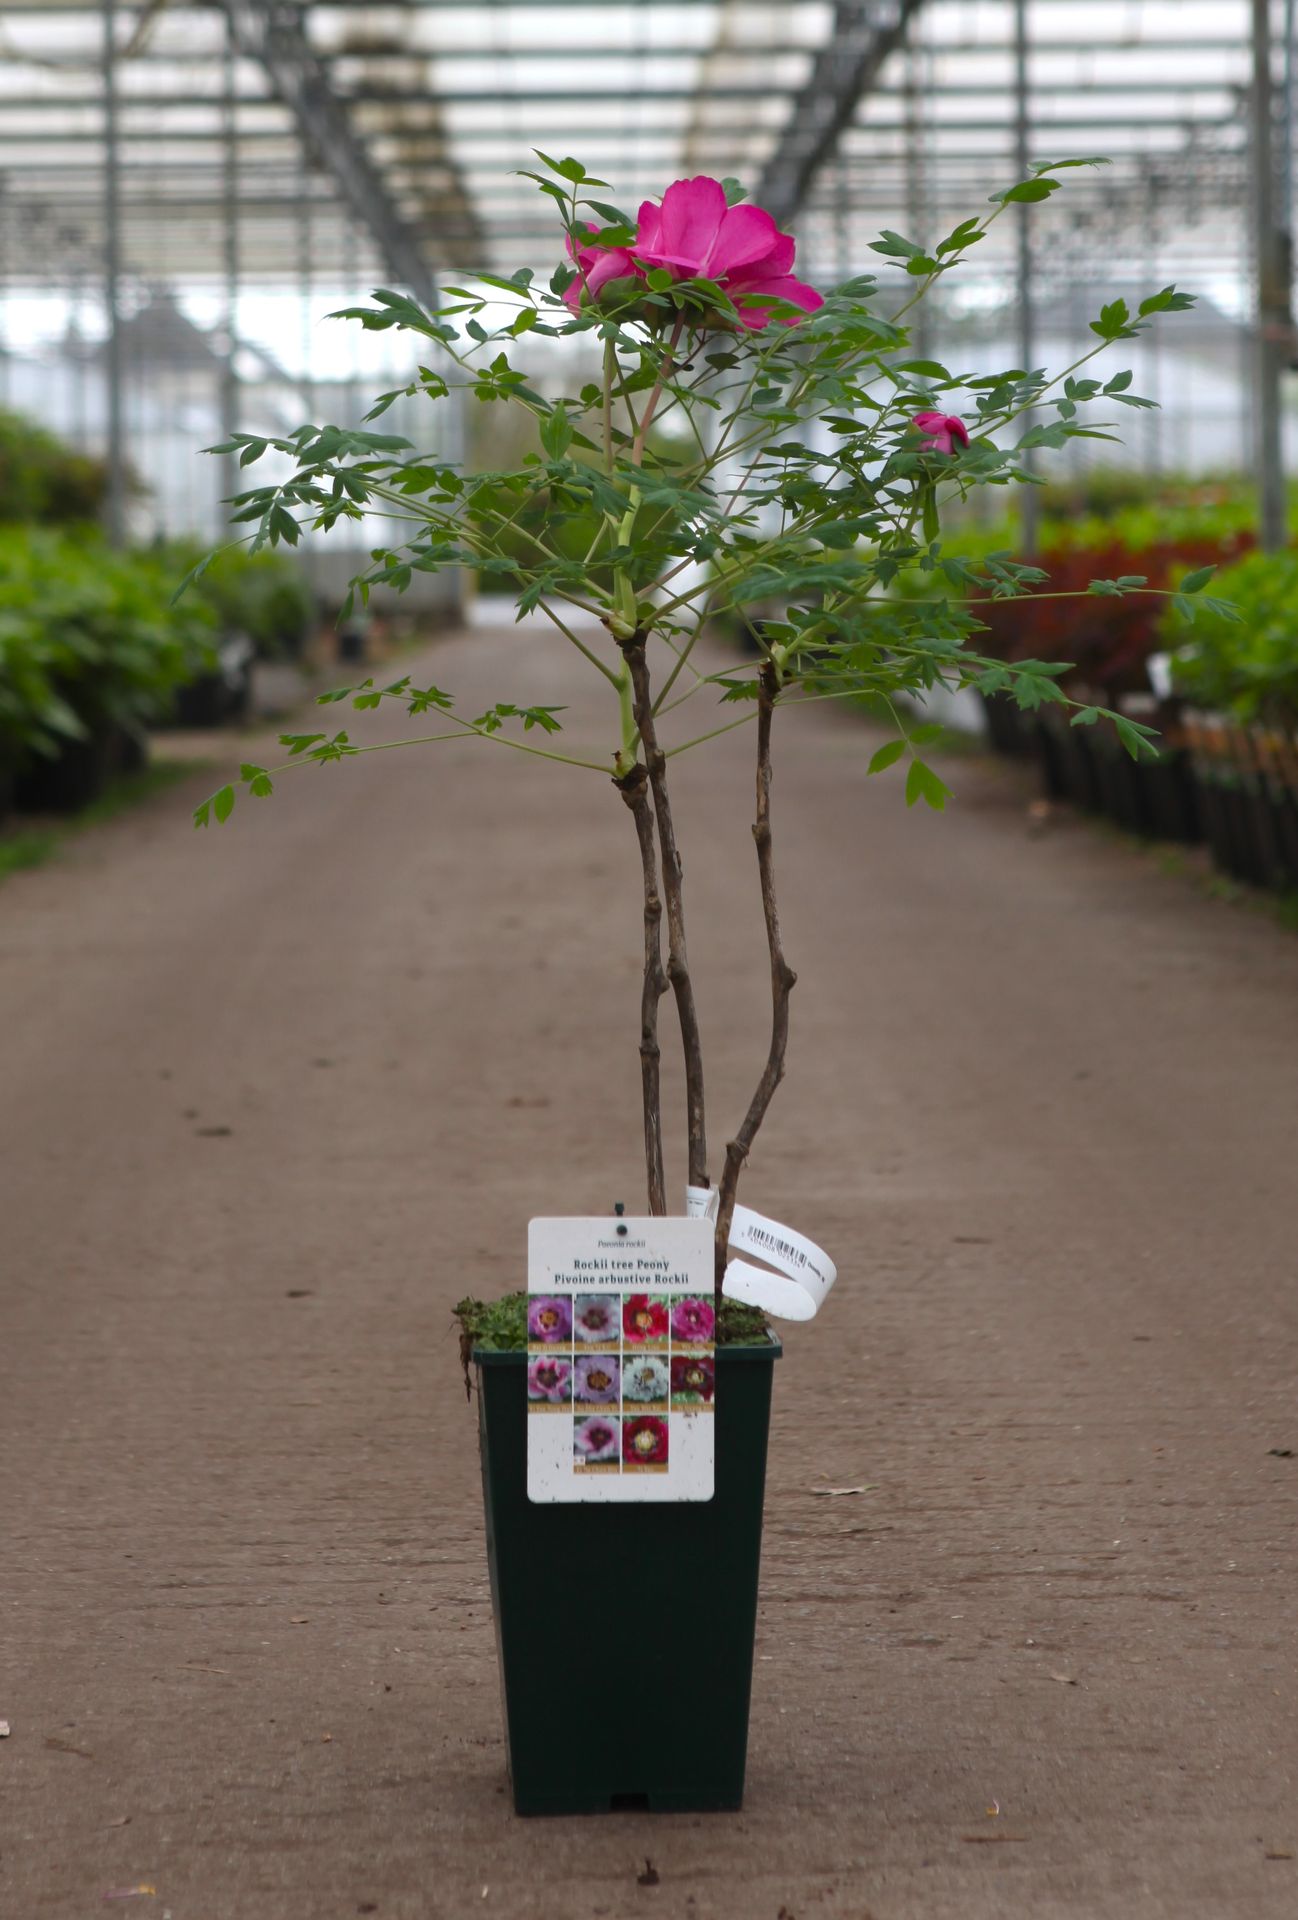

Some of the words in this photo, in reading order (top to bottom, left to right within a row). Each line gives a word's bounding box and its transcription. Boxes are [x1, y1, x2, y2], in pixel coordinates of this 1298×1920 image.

[574, 1259, 608, 1270] Rockii
[611, 1260, 634, 1270] tree
[637, 1260, 669, 1272] Peony
[554, 1274, 595, 1284] Pivoine
[598, 1274, 651, 1284] arbustive
[654, 1274, 689, 1284] Rockii
